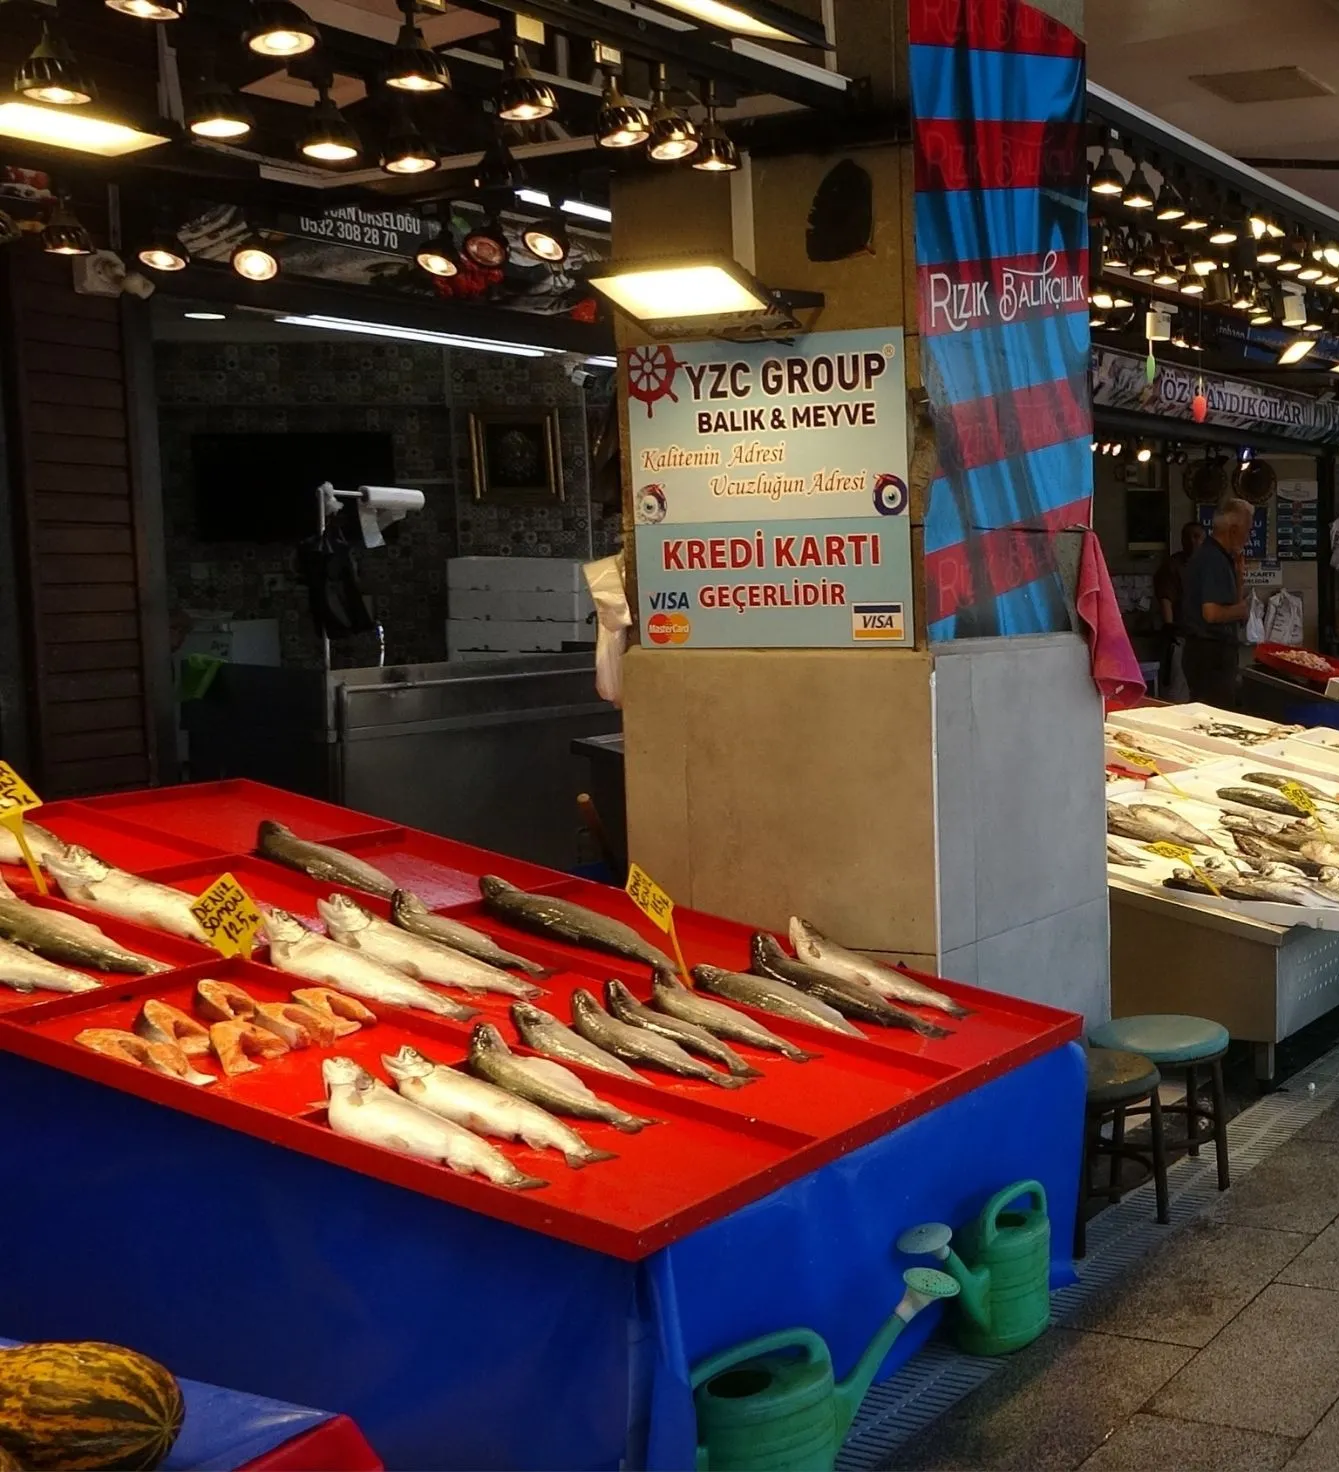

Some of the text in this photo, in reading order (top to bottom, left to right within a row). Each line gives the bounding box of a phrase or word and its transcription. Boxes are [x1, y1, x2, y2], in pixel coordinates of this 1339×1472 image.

[300, 217, 398, 249] 0532 308 28 70
[930, 272, 990, 332] RIZIK
[685, 352, 887, 401] YZC GROUP
[1163, 369, 1189, 402] ÖZ
[697, 402, 877, 434] BALIK & MEYVE
[641, 442, 785, 471] Kalitenin Adresi
[710, 470, 867, 501] Ucuzluğun Adresi
[663, 530, 881, 571] KREDİ KARTI
[649, 591, 690, 610] VISA
[699, 579, 846, 614] GEÇERLİDİR
[649, 623, 690, 634] MasterCard
[862, 615, 894, 629] VISA
